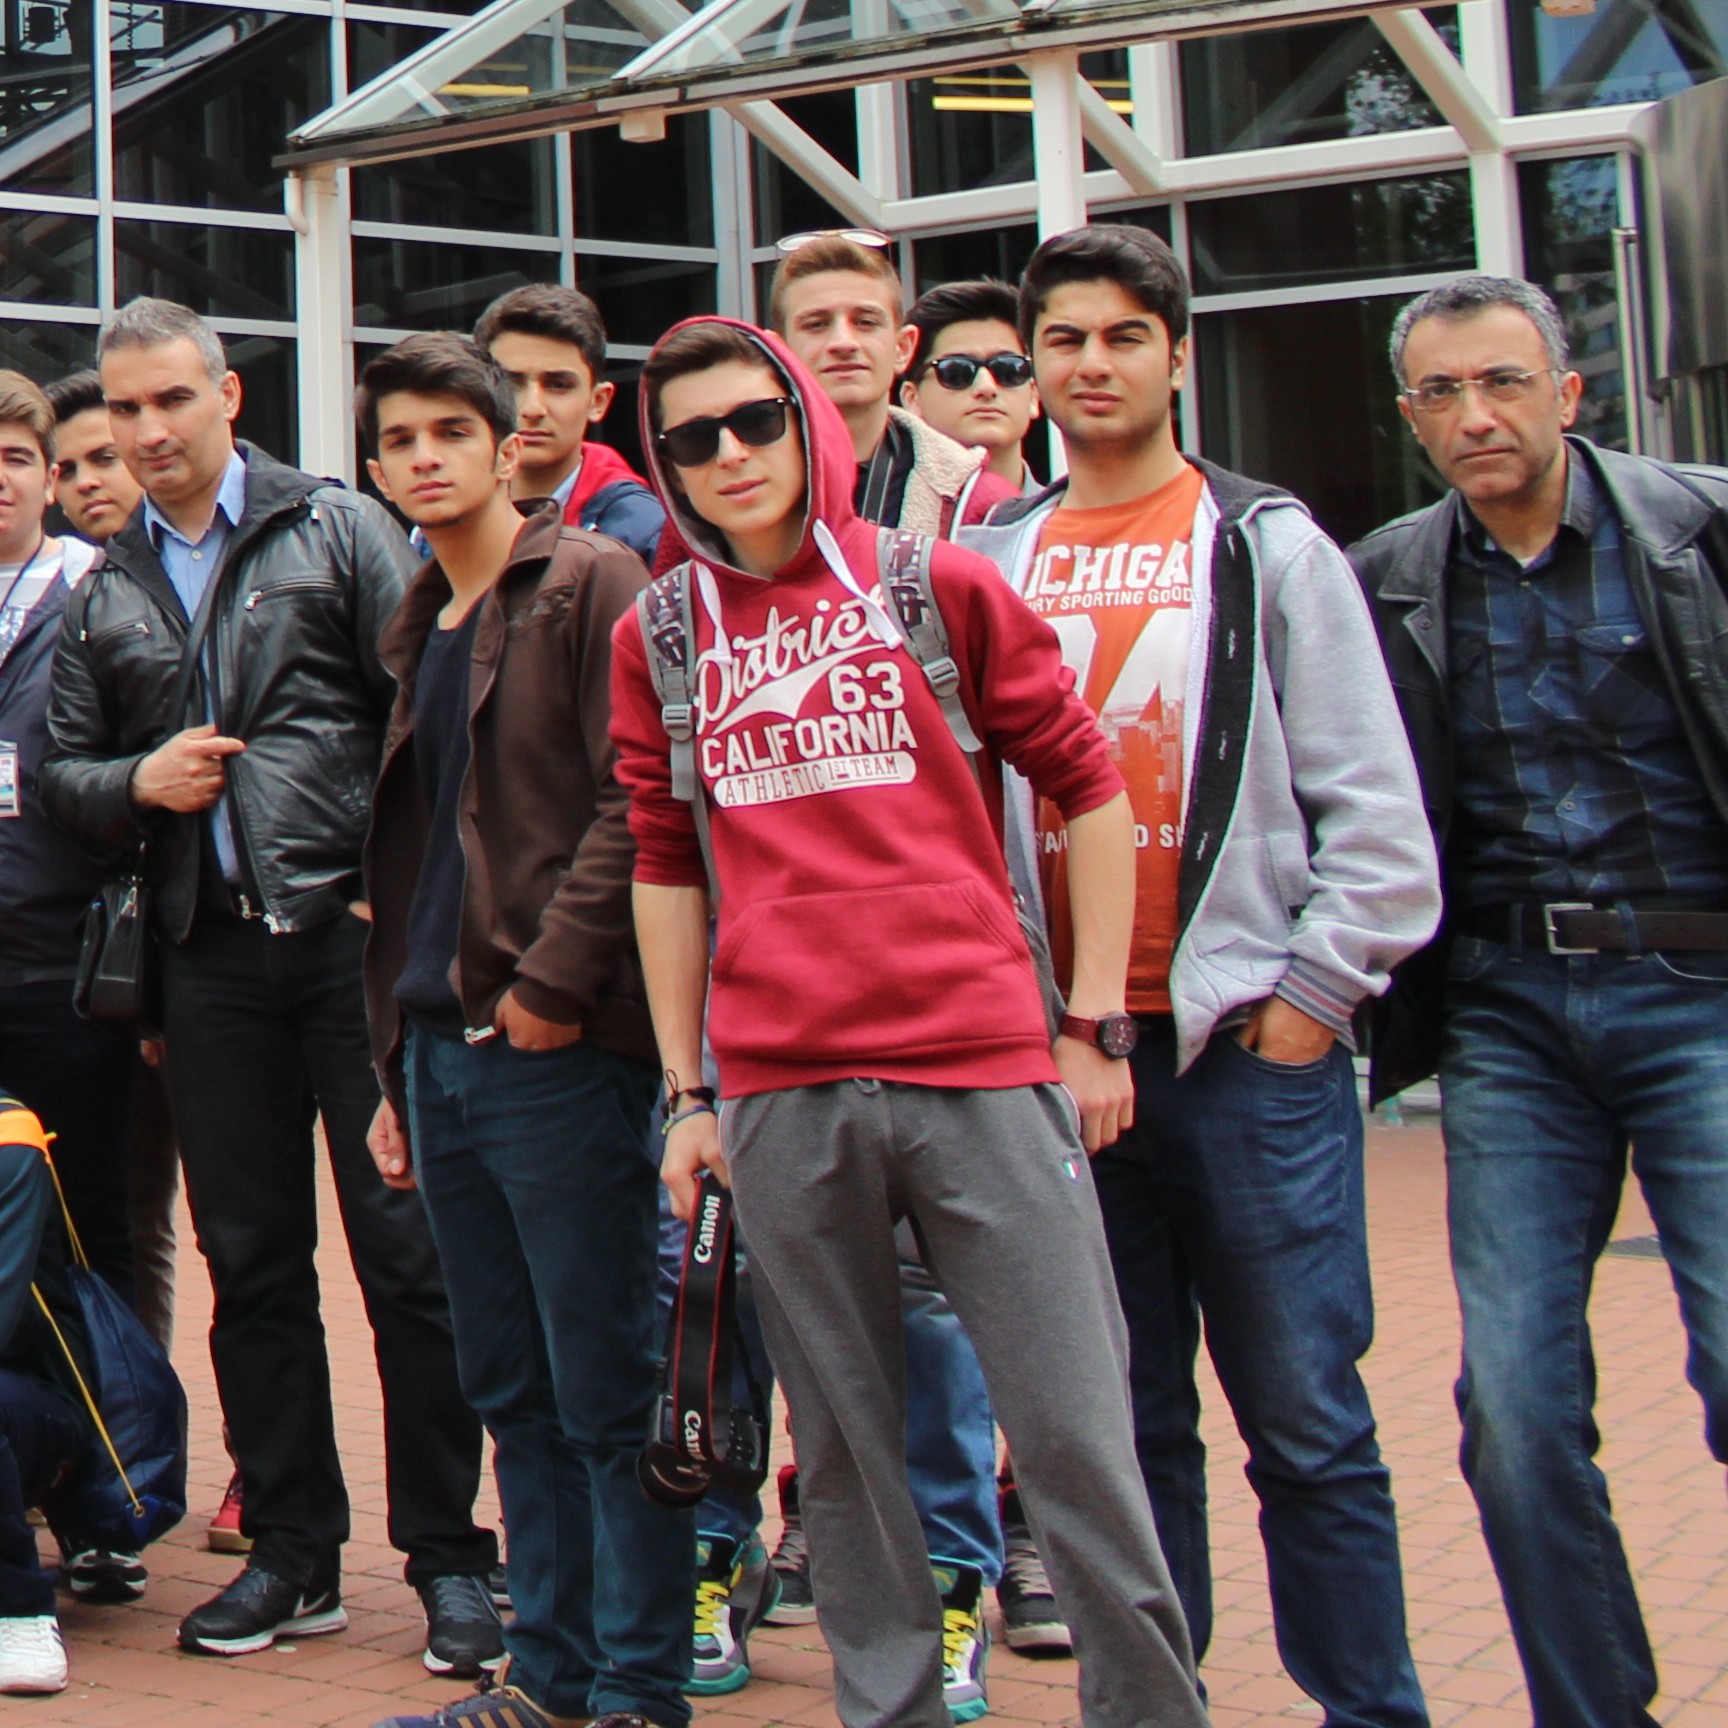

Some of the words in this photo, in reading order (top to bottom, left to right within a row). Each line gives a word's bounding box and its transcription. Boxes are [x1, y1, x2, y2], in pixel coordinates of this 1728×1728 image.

[1024, 539, 1193, 600] ICHIGA
[1060, 590, 1144, 610] SPORTING
[828, 661, 905, 713] 63
[701, 710, 918, 778] CALIFORNIA
[724, 763, 826, 805] ATHLETIC
[849, 755, 899, 776] TEAM
[693, 1194, 721, 1264] Canon
